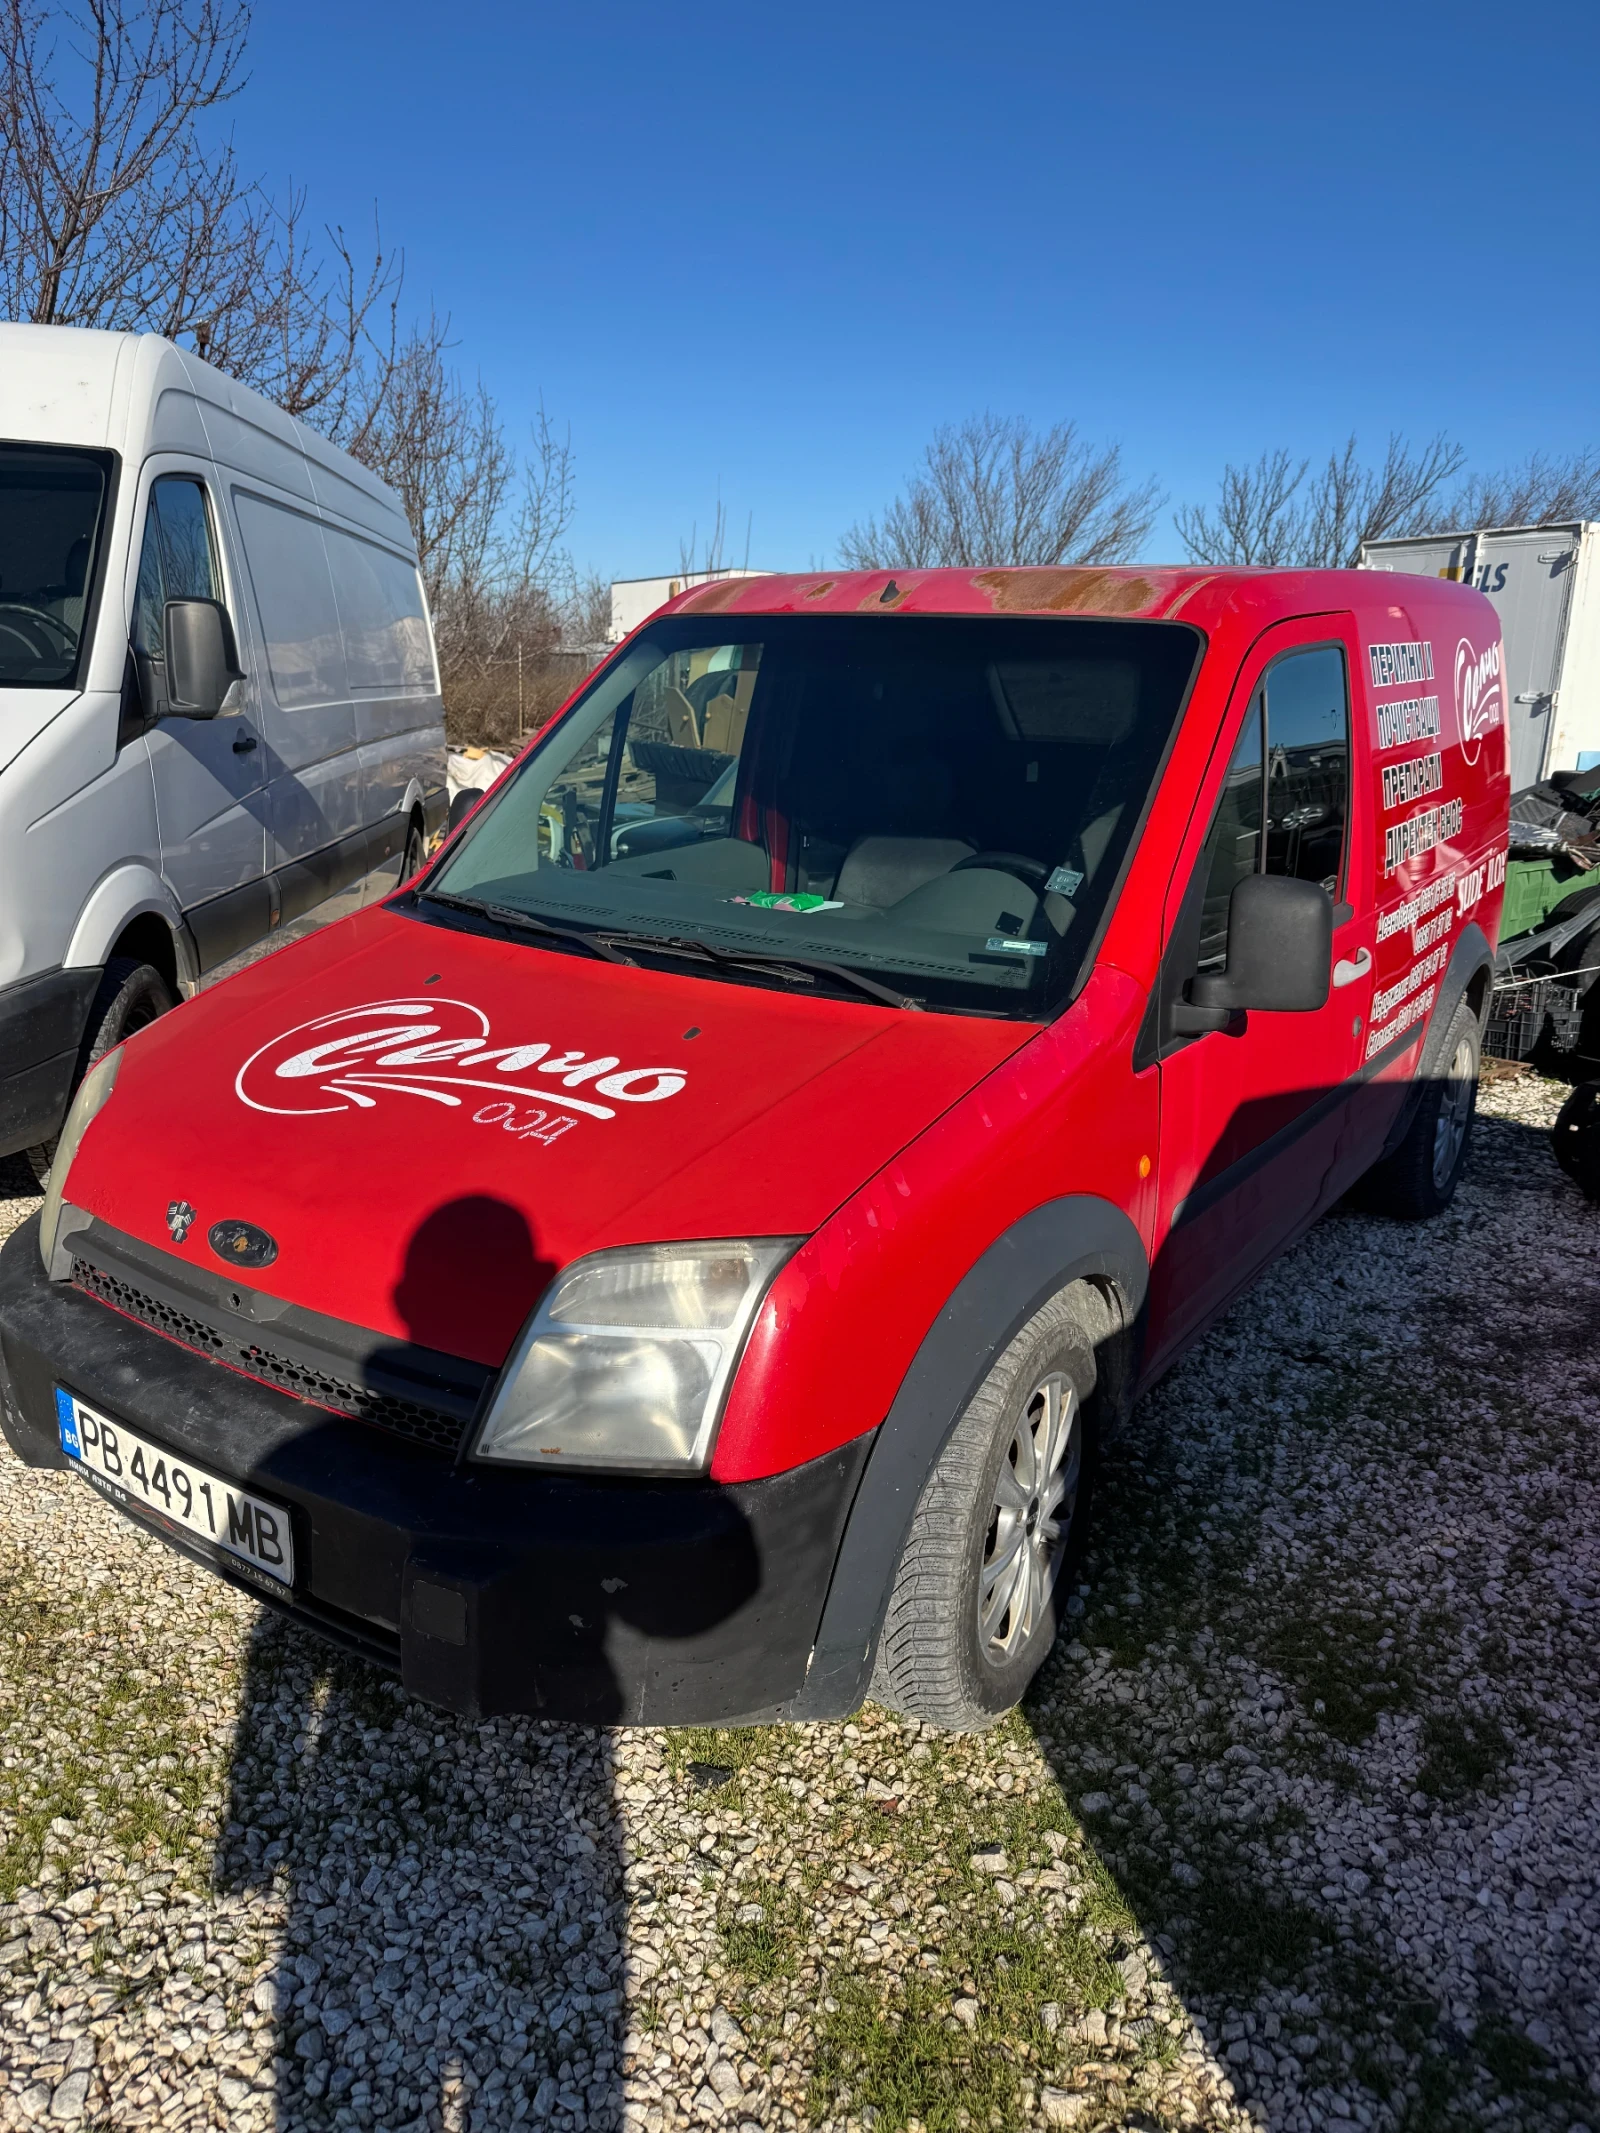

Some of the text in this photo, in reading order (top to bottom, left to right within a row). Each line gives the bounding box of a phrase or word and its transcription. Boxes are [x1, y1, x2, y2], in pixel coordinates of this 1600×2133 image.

[1368, 641, 1435, 688] ПЕРИЛНИ И
[1376, 695, 1441, 750] ПОЧИСТВАЩИ
[1381, 751, 1443, 811] ПРЕПАРАТИ
[1384, 797, 1463, 879] ДИРЕКТЕН ВНОС
[65, 1428, 79, 1449] BG
[78, 1408, 284, 1566] PB 4491 MB
